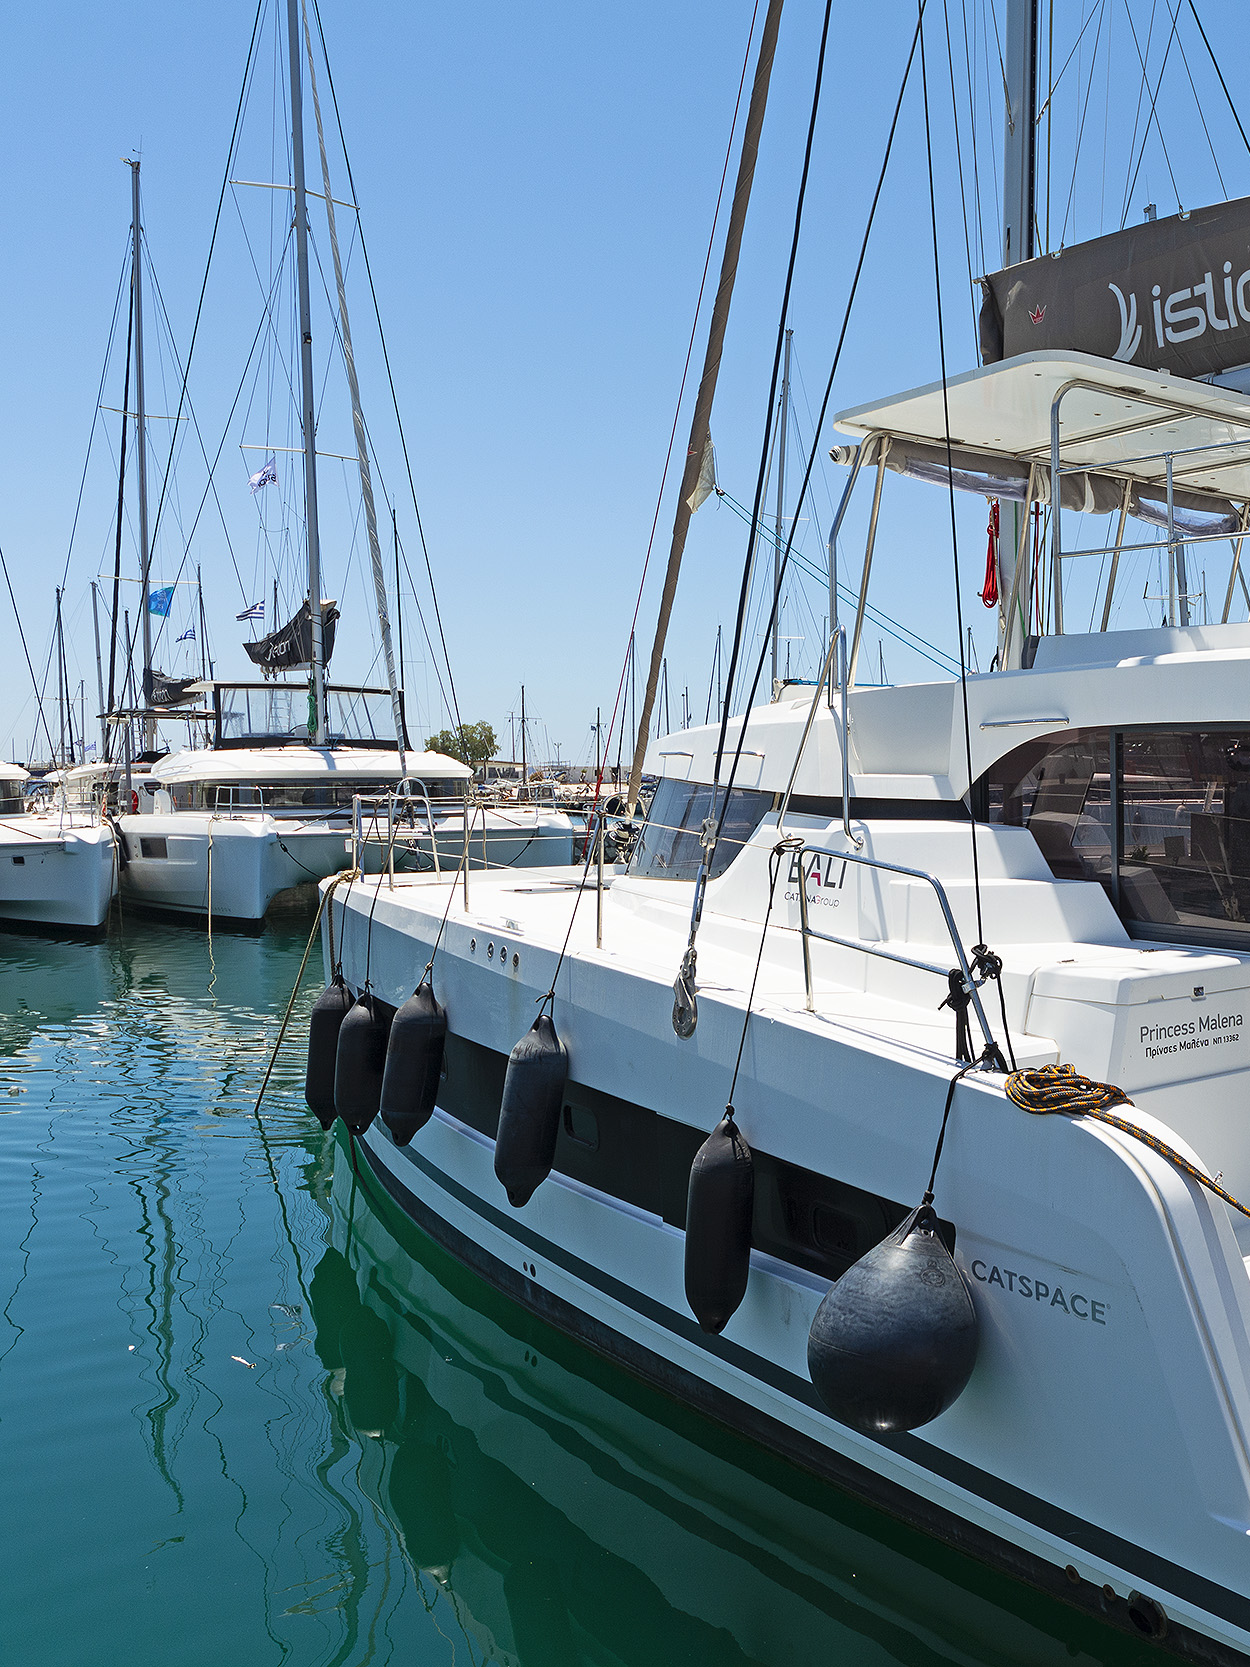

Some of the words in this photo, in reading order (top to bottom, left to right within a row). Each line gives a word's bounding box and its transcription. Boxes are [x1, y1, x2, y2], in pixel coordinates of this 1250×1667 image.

[784, 891, 840, 909] CATNAGroup
[1140, 1023, 1196, 1043] Princess
[1198, 1013, 1243, 1032] Malena
[1145, 1045, 1178, 1059] Πρίνσες
[971, 1259, 1107, 1326] CATSPACE
